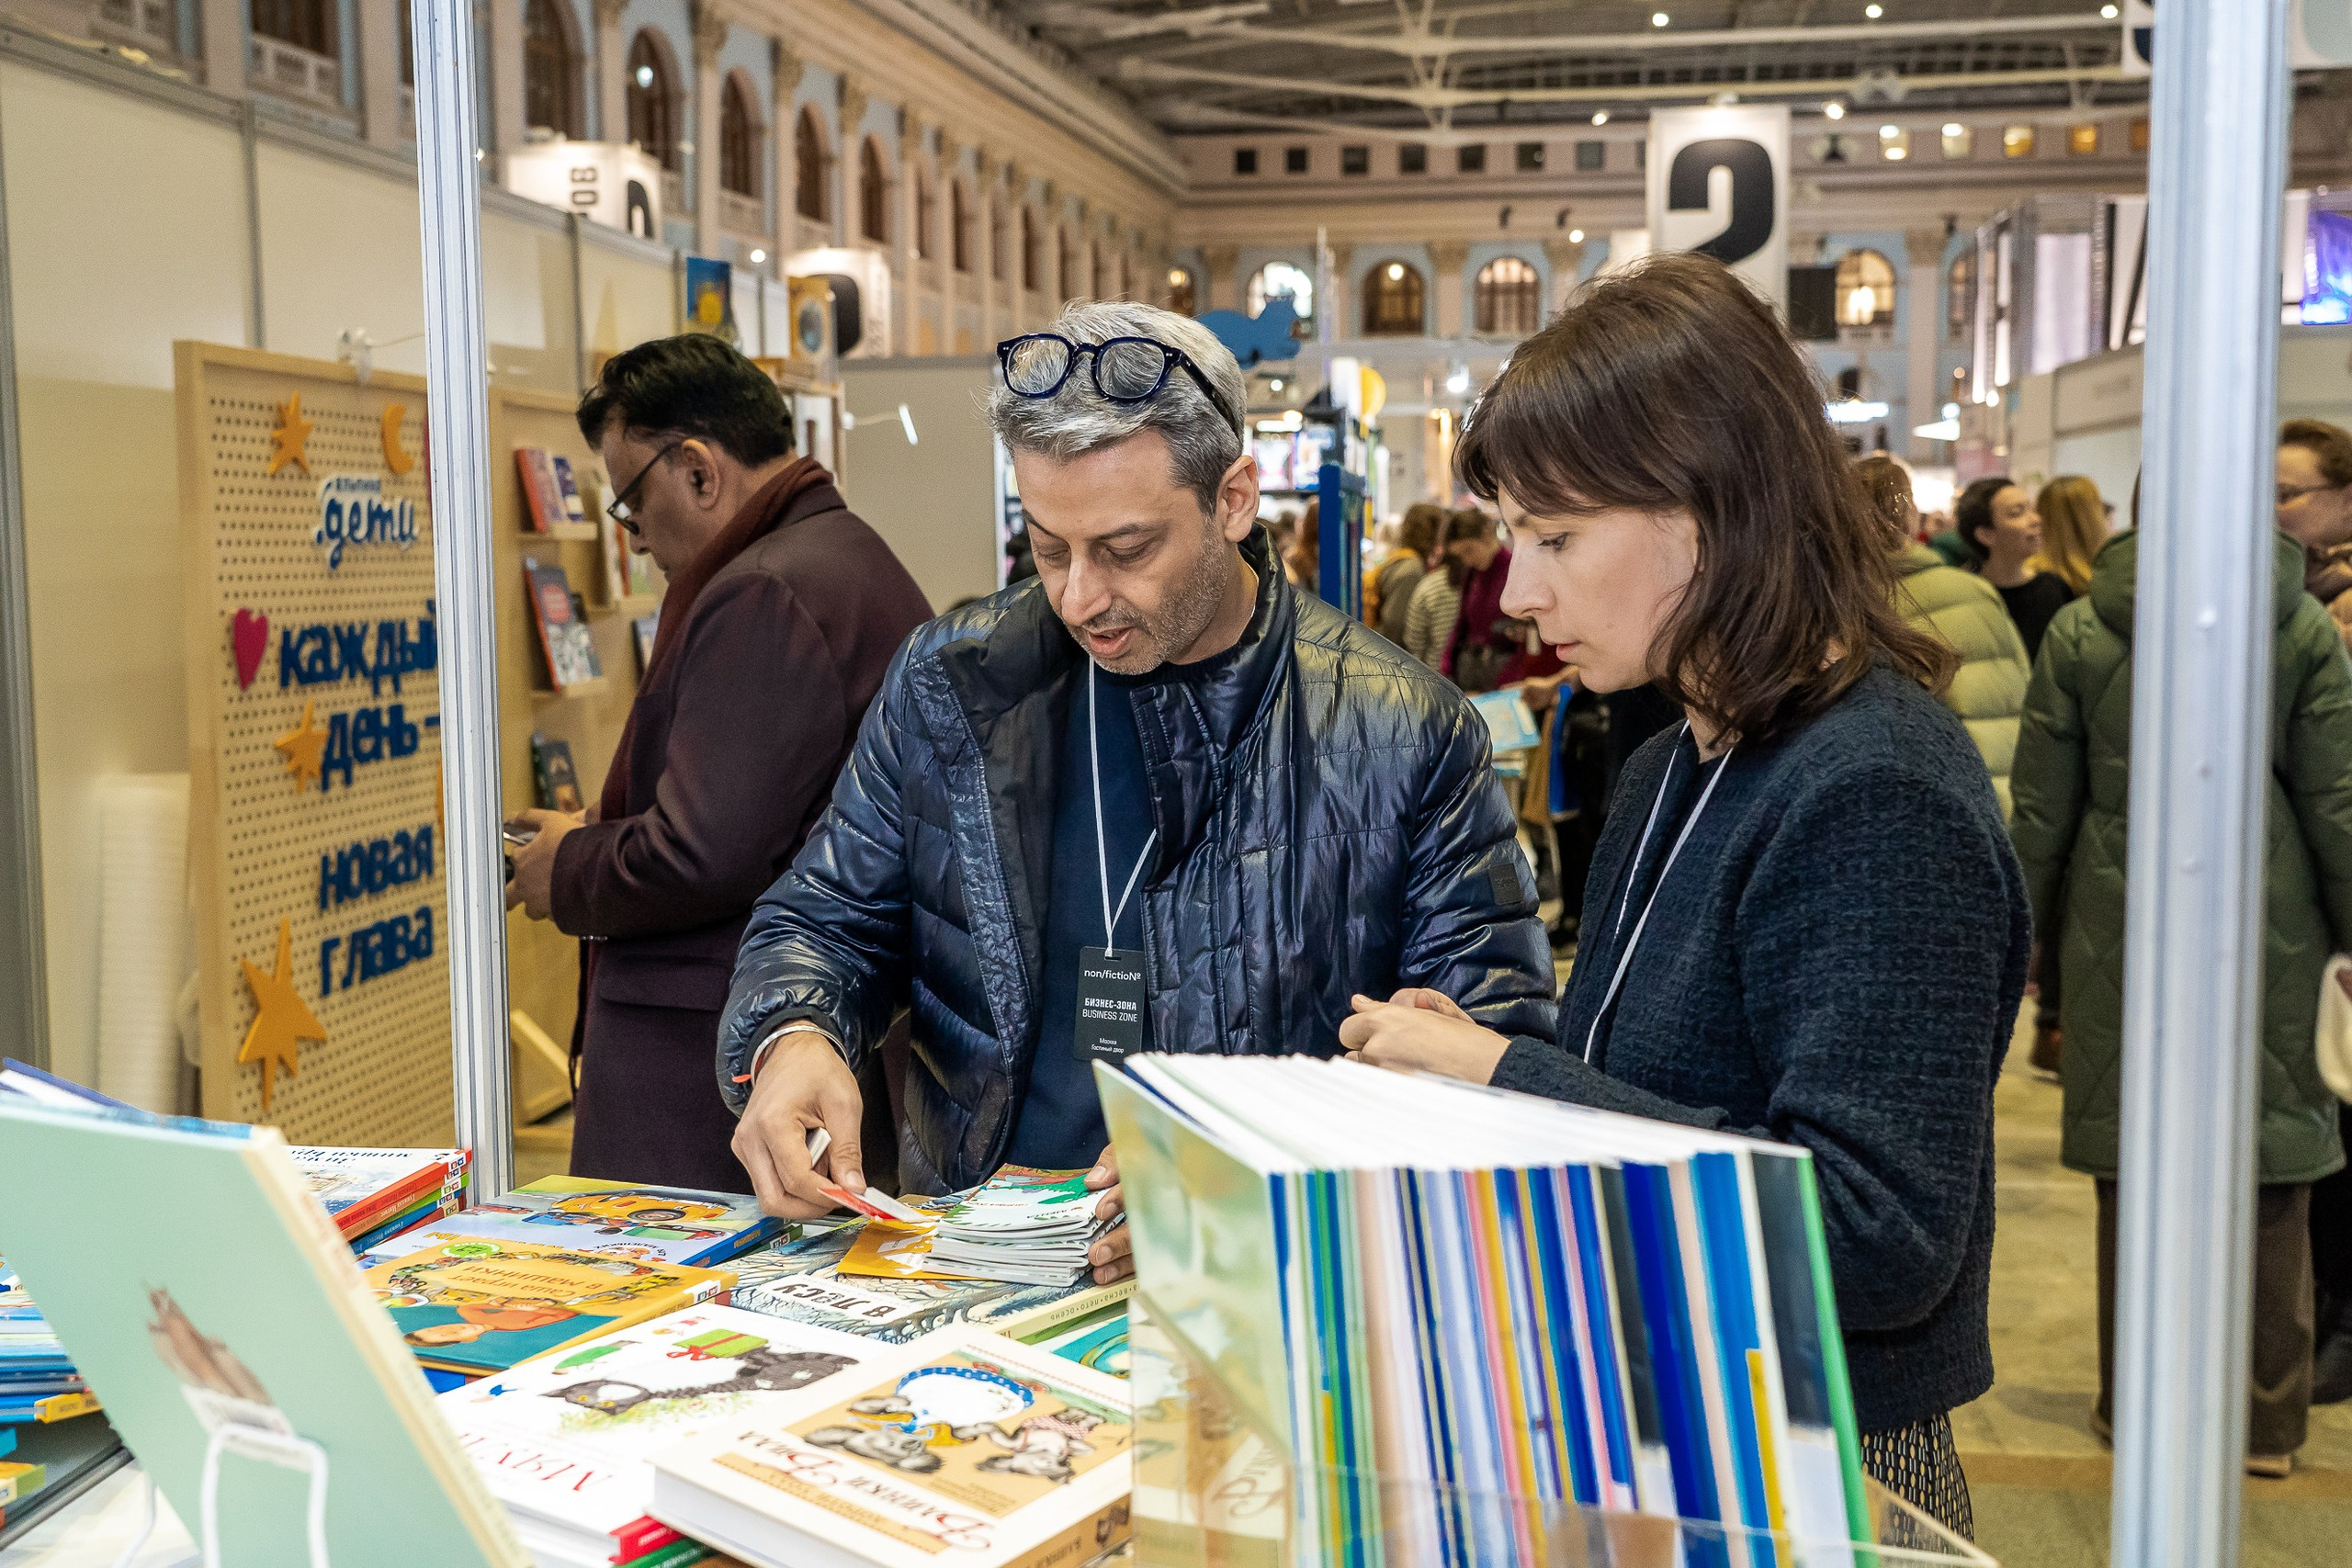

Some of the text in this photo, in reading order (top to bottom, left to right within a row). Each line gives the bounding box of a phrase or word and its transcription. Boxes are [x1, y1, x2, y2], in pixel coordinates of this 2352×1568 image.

[322, 704, 419, 793] день
[321, 824, 433, 909] новая
[321, 906, 433, 996] глава
[1082, 1009, 1137, 1022] BUSINESS ZONE
[1084, 998, 1136, 1010] БИЗНЕС-ЗОНА
[1091, 1043, 1113, 1052] Гостиный
[1099, 1037, 1117, 1045] Москва
[447, 1275, 576, 1297] Саша играет
[463, 1265, 585, 1287] машинки
[773, 1283, 897, 1318] В лесу
[738, 1429, 842, 1486] Билл
[846, 1473, 994, 1551] Блинки
